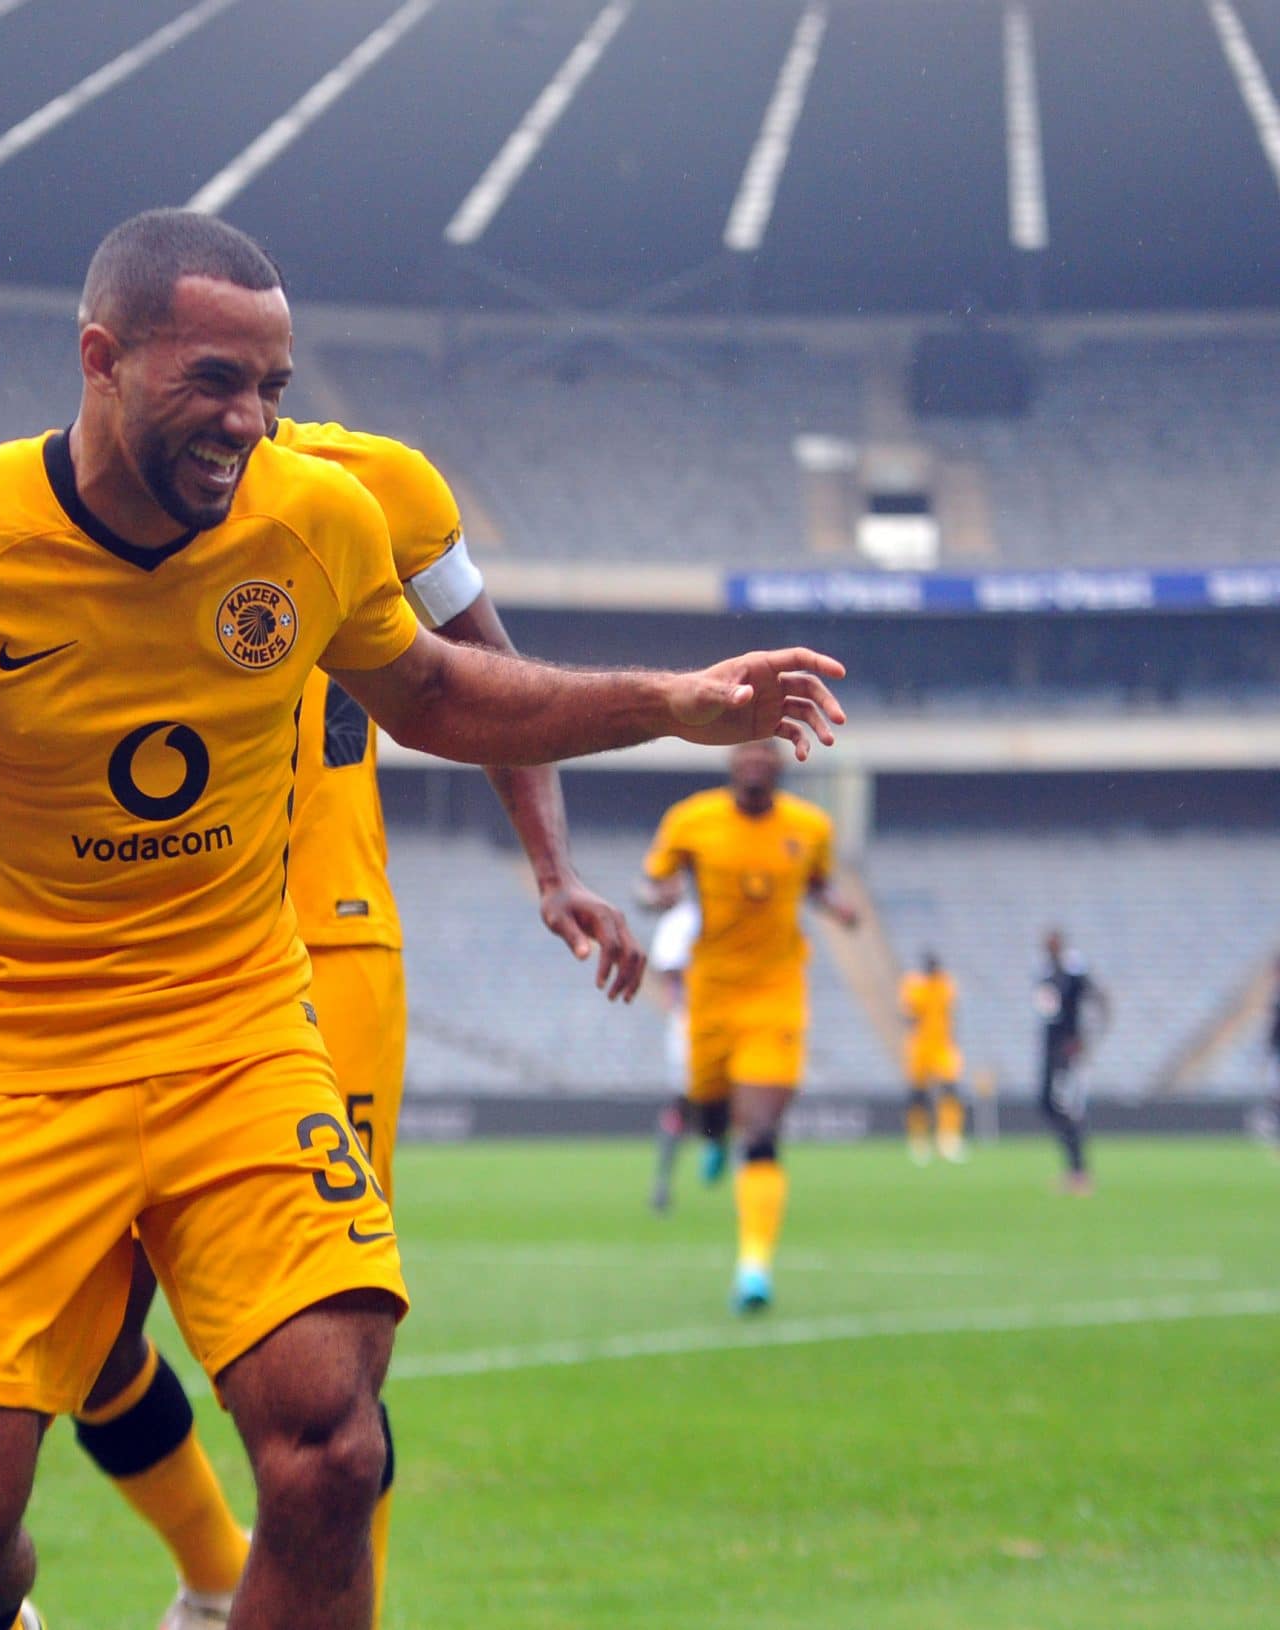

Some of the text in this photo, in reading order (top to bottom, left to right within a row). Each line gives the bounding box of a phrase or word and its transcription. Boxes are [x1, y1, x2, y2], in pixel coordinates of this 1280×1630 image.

[227, 587, 280, 618] KAIZER
[233, 634, 287, 663] CHIEFS
[72, 824, 233, 862] vodacom
